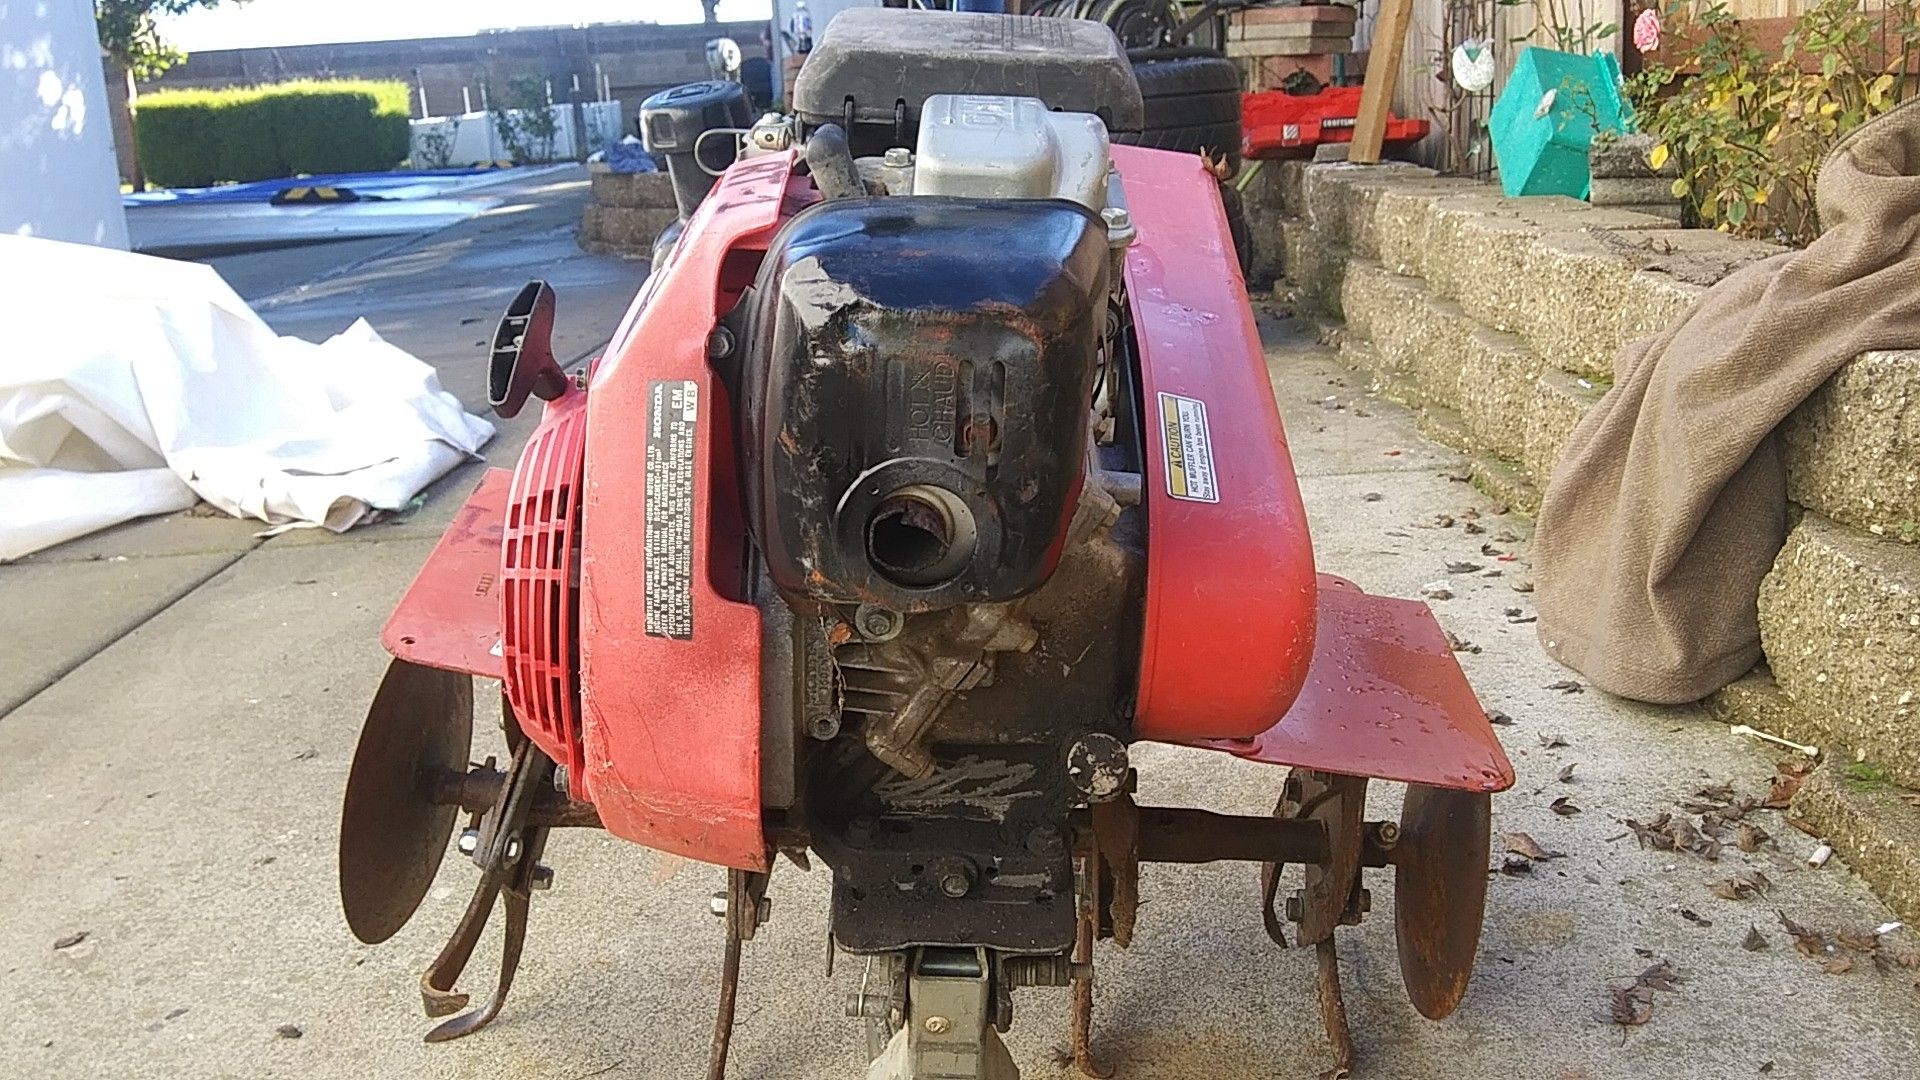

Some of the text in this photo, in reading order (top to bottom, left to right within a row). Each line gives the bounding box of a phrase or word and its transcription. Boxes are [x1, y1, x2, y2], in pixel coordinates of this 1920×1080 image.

[672, 390, 683, 408] EM
[932, 362, 955, 443] CHAUD
[653, 384, 663, 438] HONDA
[908, 401, 930, 441] HOT
[670, 422, 678, 430] TO
[1183, 424, 1192, 439] BURN
[1168, 421, 1181, 459] CAUTION
[1185, 440, 1194, 452] CAN
[677, 440, 685, 483] REGULATIONS
[1186, 454, 1197, 479] MUFFLER
[1197, 448, 1206, 464] engine
[1190, 481, 1198, 492] HOT
